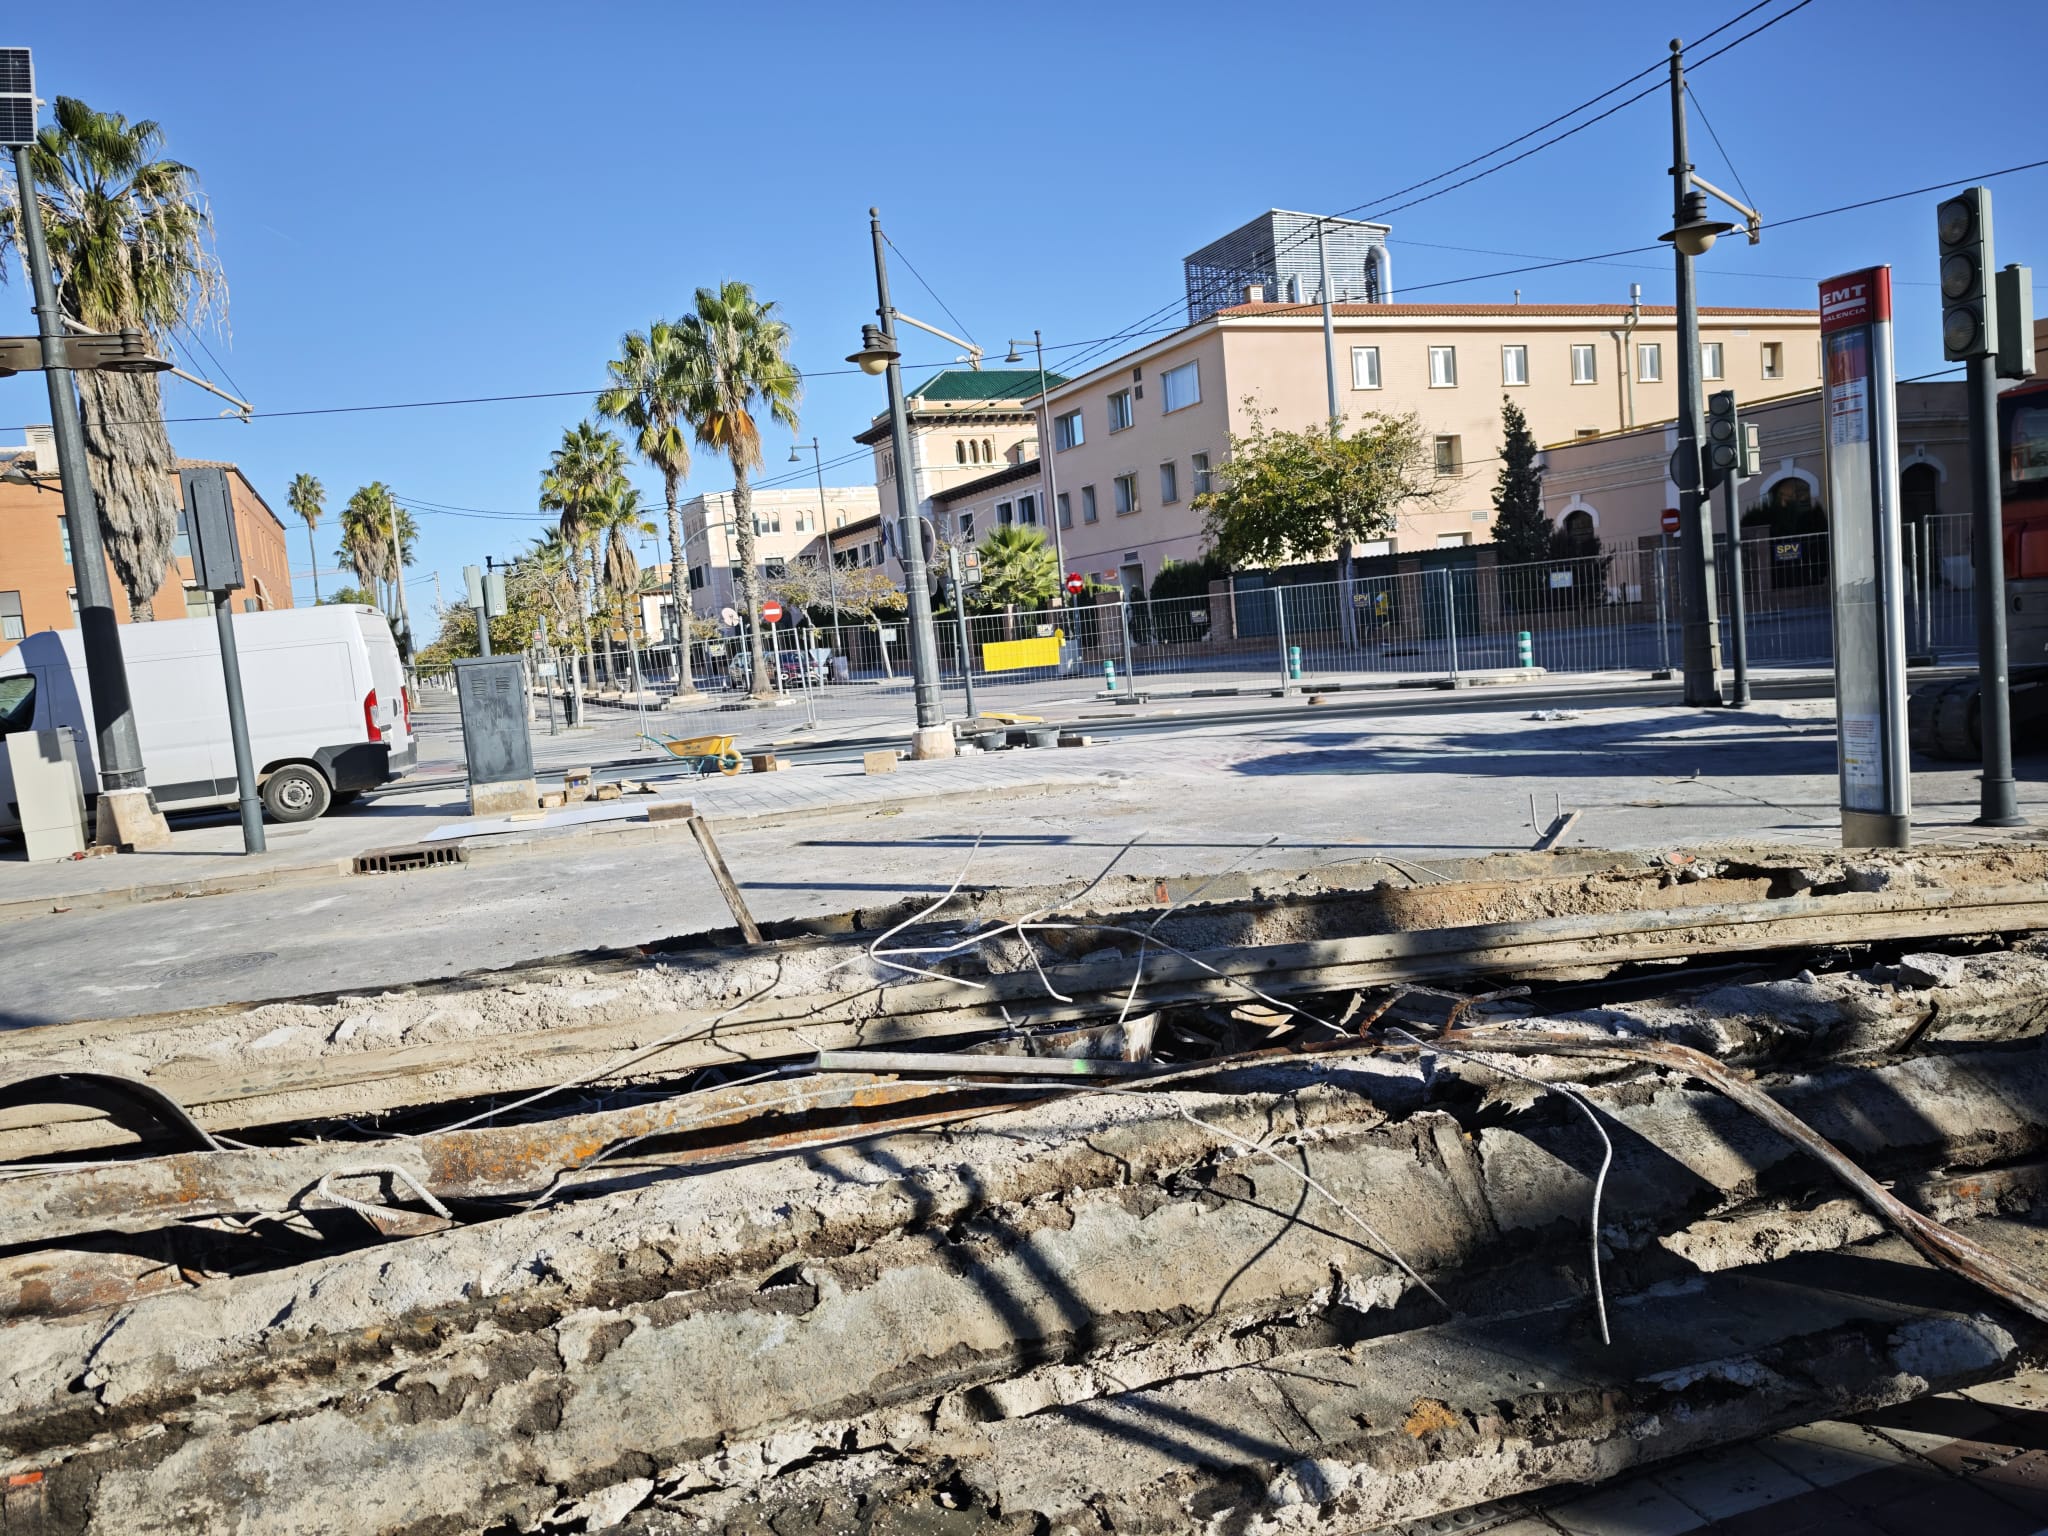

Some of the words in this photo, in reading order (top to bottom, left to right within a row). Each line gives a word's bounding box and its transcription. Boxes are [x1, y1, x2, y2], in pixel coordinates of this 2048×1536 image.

[1822, 284, 1866, 306] EMT
[1776, 543, 1799, 554] SPV
[1353, 593, 1368, 602] SPV
